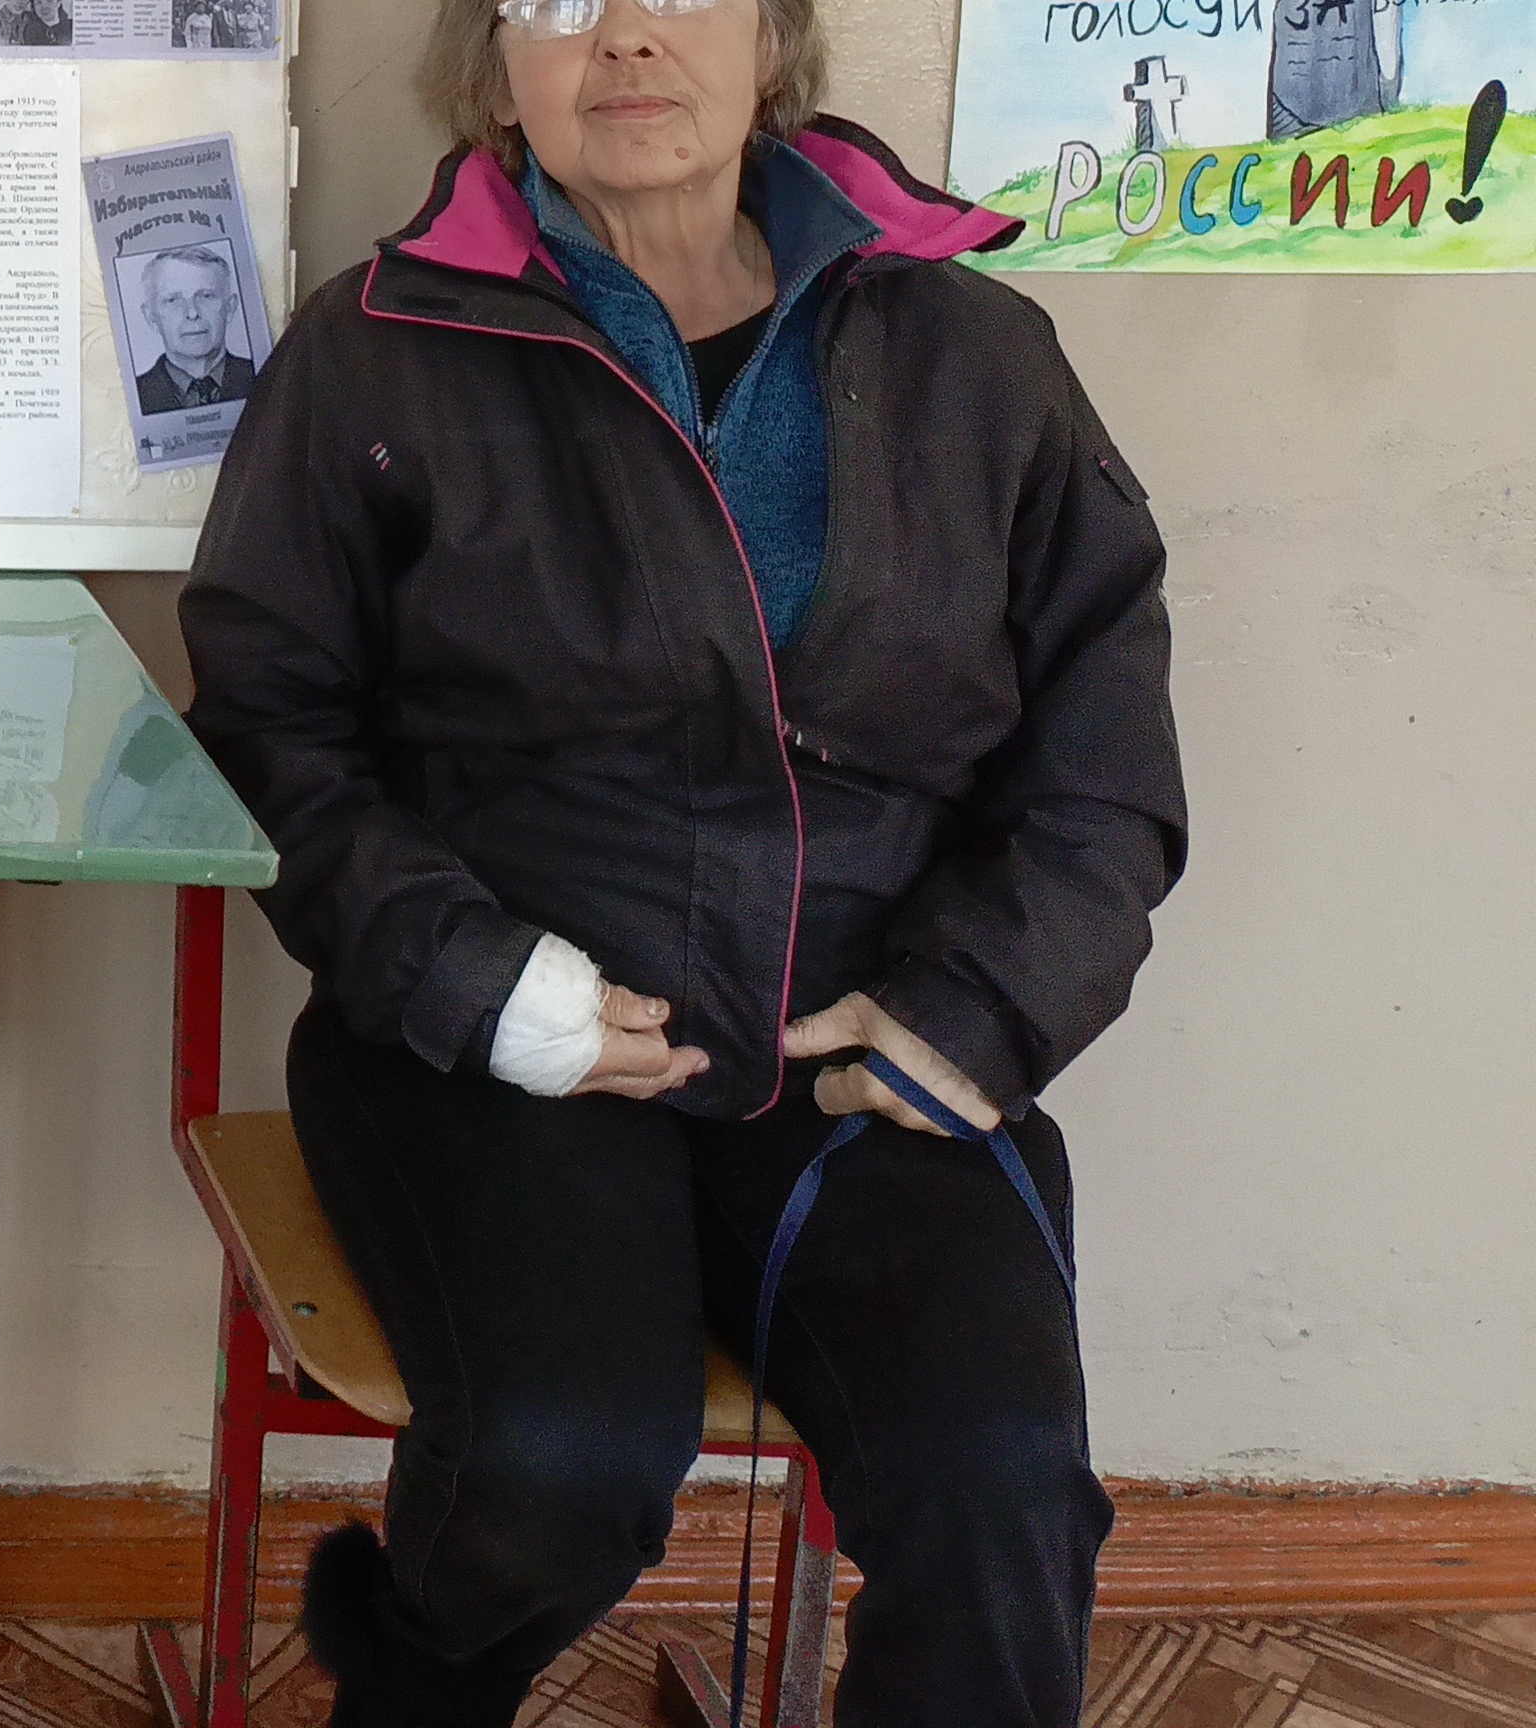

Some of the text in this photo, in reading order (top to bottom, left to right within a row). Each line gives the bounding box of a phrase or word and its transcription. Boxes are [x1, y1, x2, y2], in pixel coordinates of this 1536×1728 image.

[124, 148, 221, 176] Андреапольский район
[94, 178, 232, 222] Избирательный
[115, 209, 226, 253] участок № 1
